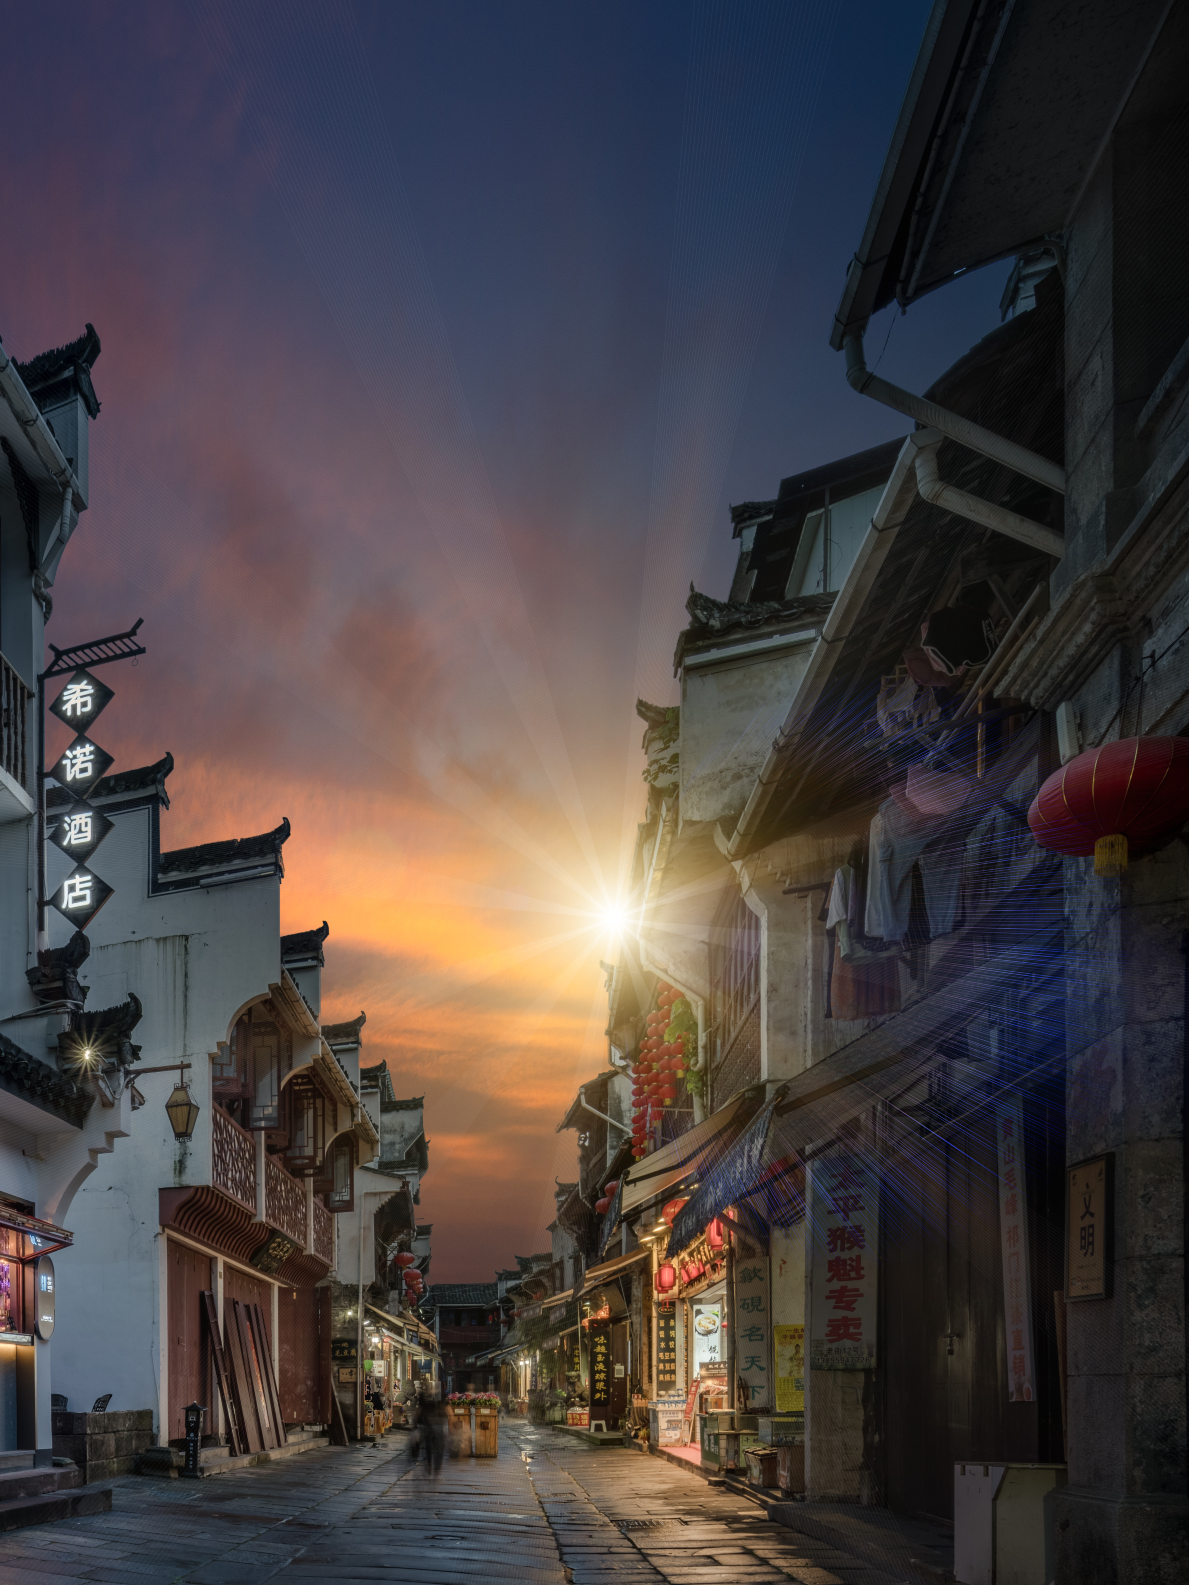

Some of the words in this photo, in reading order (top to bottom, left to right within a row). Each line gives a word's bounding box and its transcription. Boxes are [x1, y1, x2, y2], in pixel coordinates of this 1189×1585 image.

[62, 680, 93, 908] 希诺酒店
[824, 1164, 866, 1344] 太平猴魁专卖
[1080, 1182, 1095, 1258] 文明
[826, 1346, 859, 1355] 老街12号
